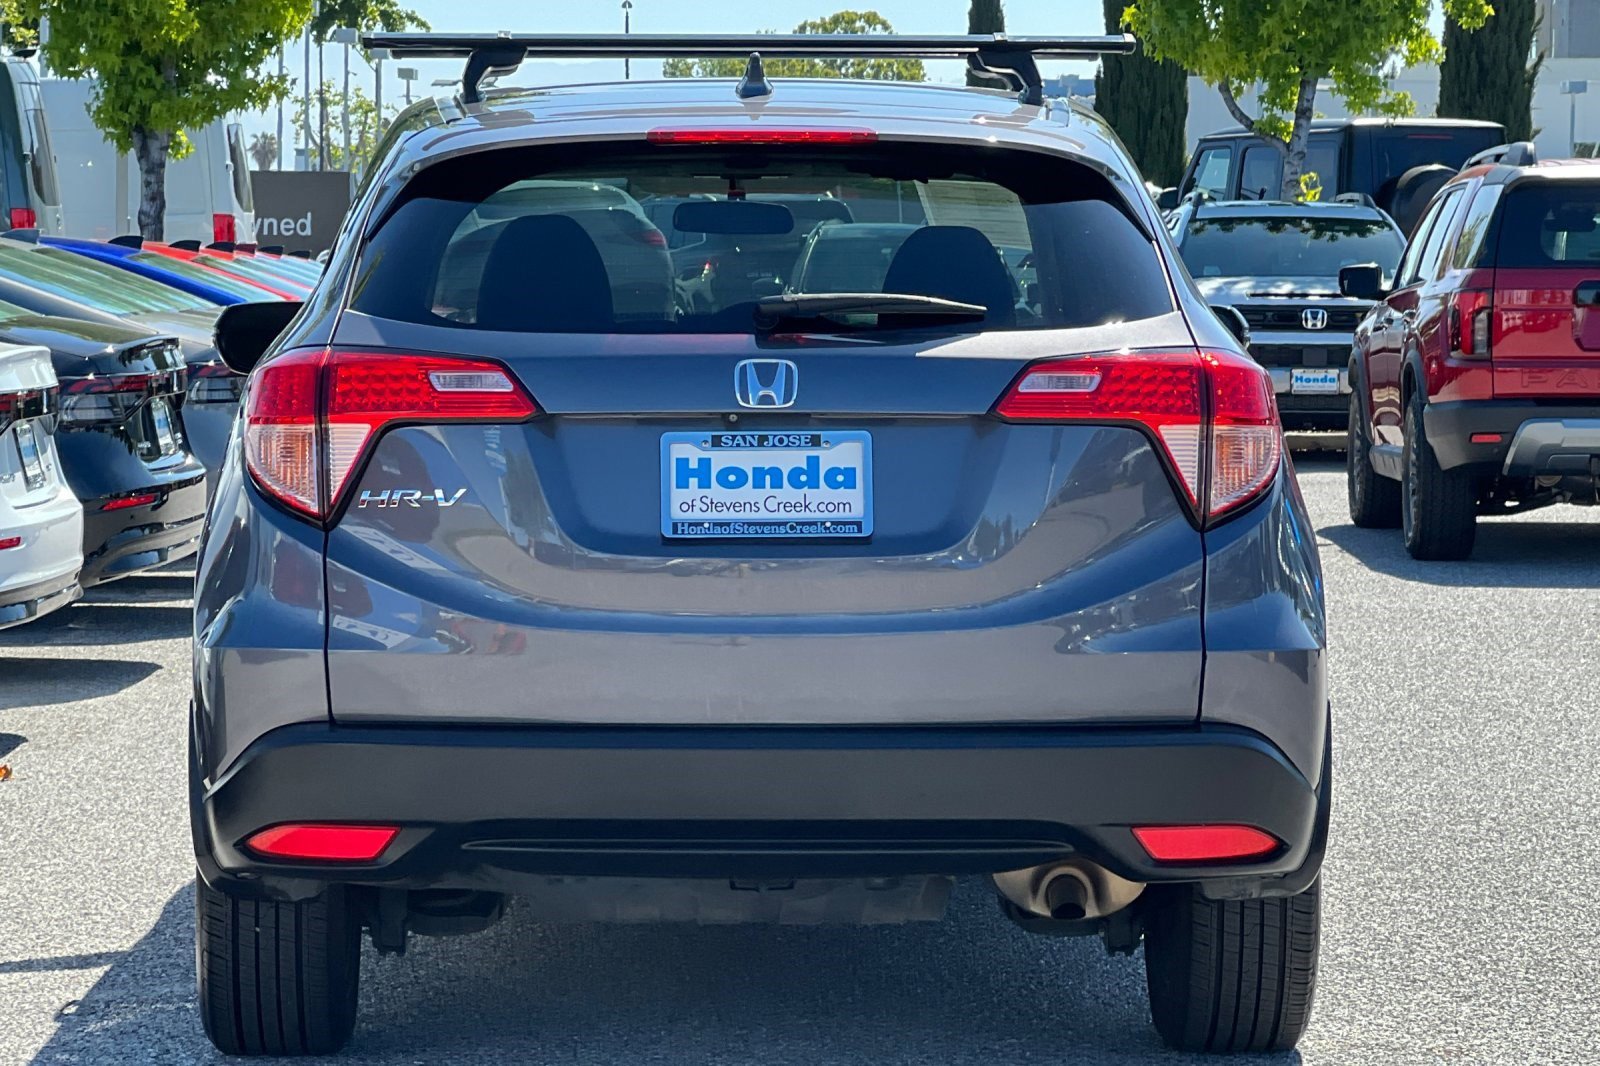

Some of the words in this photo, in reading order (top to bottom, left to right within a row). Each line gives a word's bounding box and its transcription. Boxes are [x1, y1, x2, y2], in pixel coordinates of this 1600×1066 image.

[1294, 374, 1336, 384] Honda
[1521, 367, 1600, 389] PA
[720, 435, 759, 448] SAN
[763, 435, 812, 448] JOSE
[675, 455, 857, 490] Honda
[358, 488, 467, 508] HR-V
[679, 498, 697, 513] of
[699, 495, 760, 513] Stevens
[763, 493, 852, 513] Creek.com
[677, 521, 858, 535] HondaofStevensCreek.com
